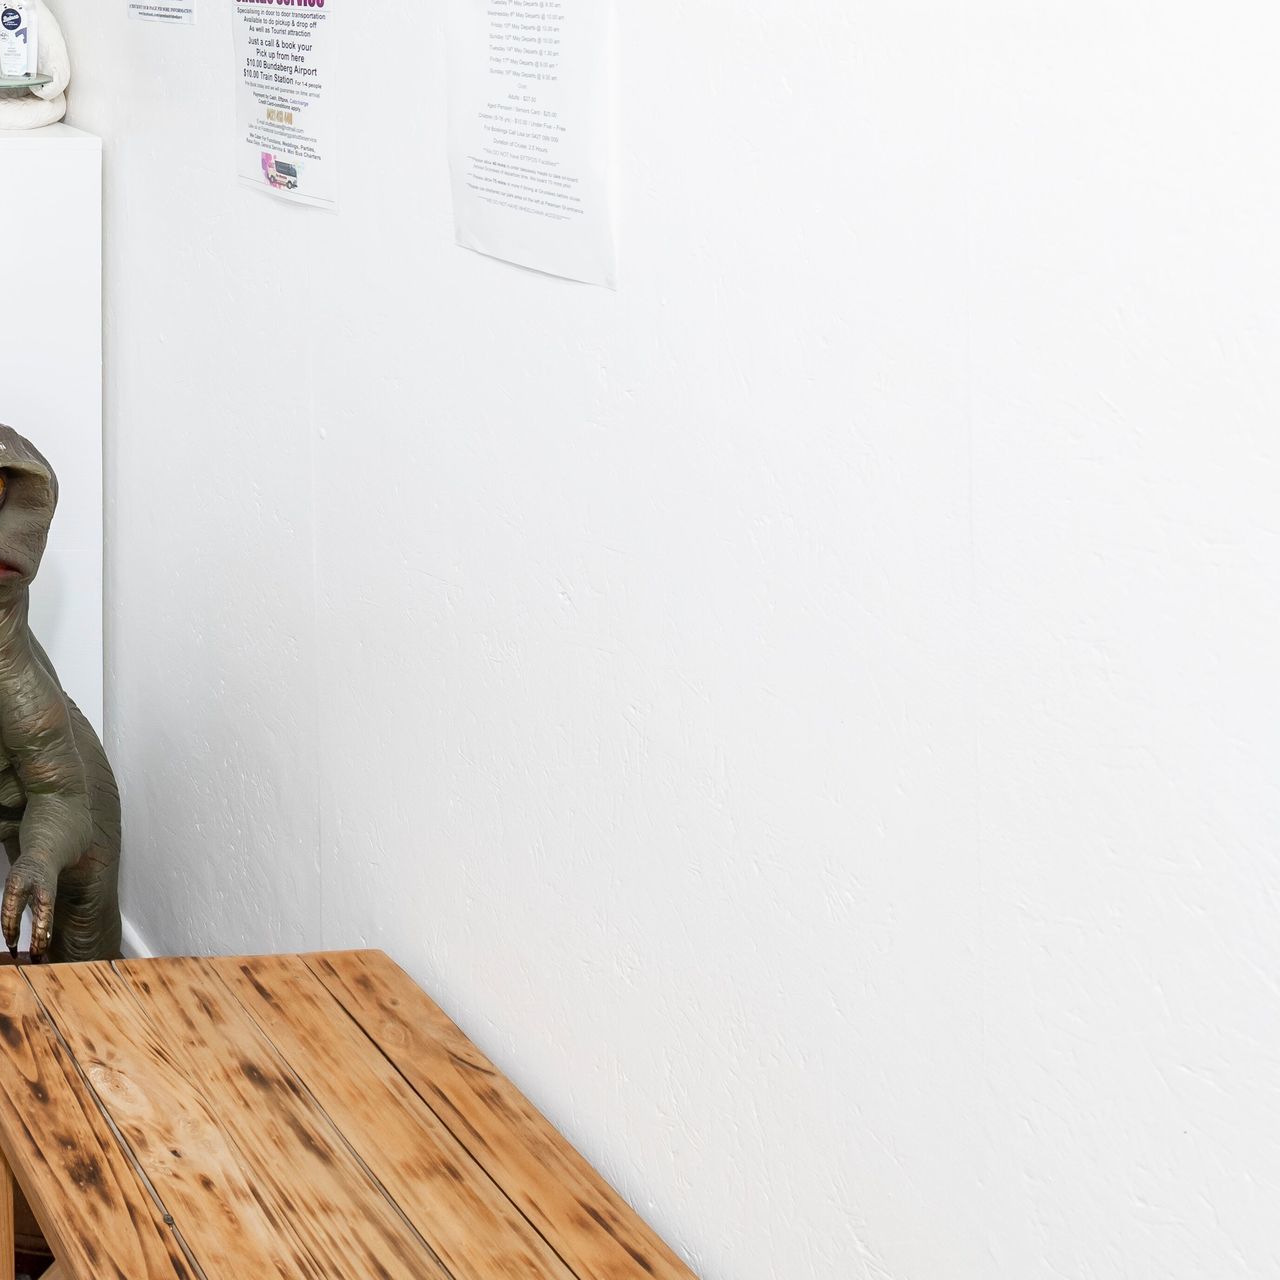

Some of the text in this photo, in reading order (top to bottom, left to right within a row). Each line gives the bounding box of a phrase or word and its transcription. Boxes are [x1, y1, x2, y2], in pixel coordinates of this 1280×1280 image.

[263, 58, 318, 77] Bundaberg Airport
[274, 72, 294, 85] Station
